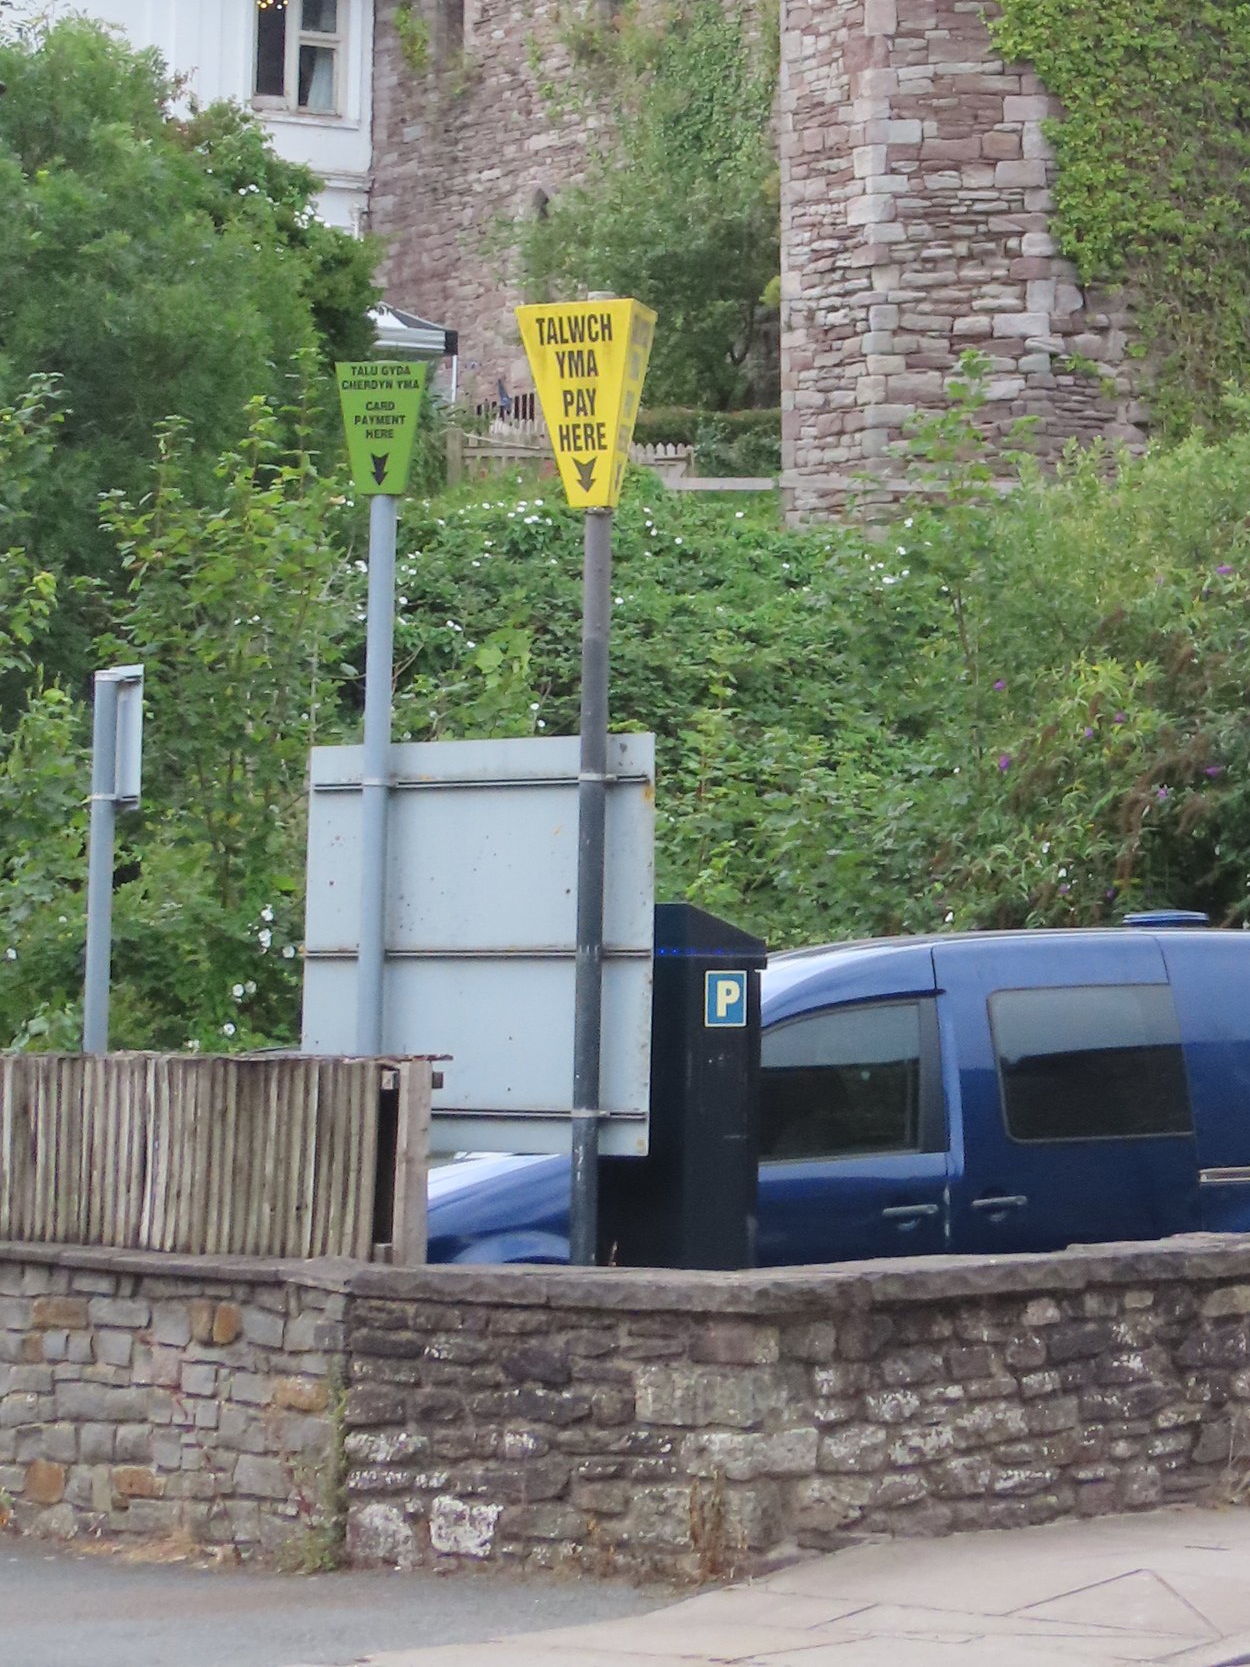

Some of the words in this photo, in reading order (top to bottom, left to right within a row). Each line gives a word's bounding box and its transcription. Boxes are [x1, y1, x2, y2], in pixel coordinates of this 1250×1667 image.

[536, 314, 612, 346] TALWCH
[351, 366, 378, 376] TALU
[381, 366, 411, 375] GYDA
[556, 349, 598, 378] YMA
[342, 380, 393, 390] CHERDYN
[397, 379, 419, 389] YMA
[365, 401, 395, 411] CARD
[562, 388, 596, 417] PAY
[354, 415, 406, 425] PAYMENT
[366, 429, 394, 439] HERE
[558, 422, 607, 452] HERE
[716, 980, 740, 1018] P
